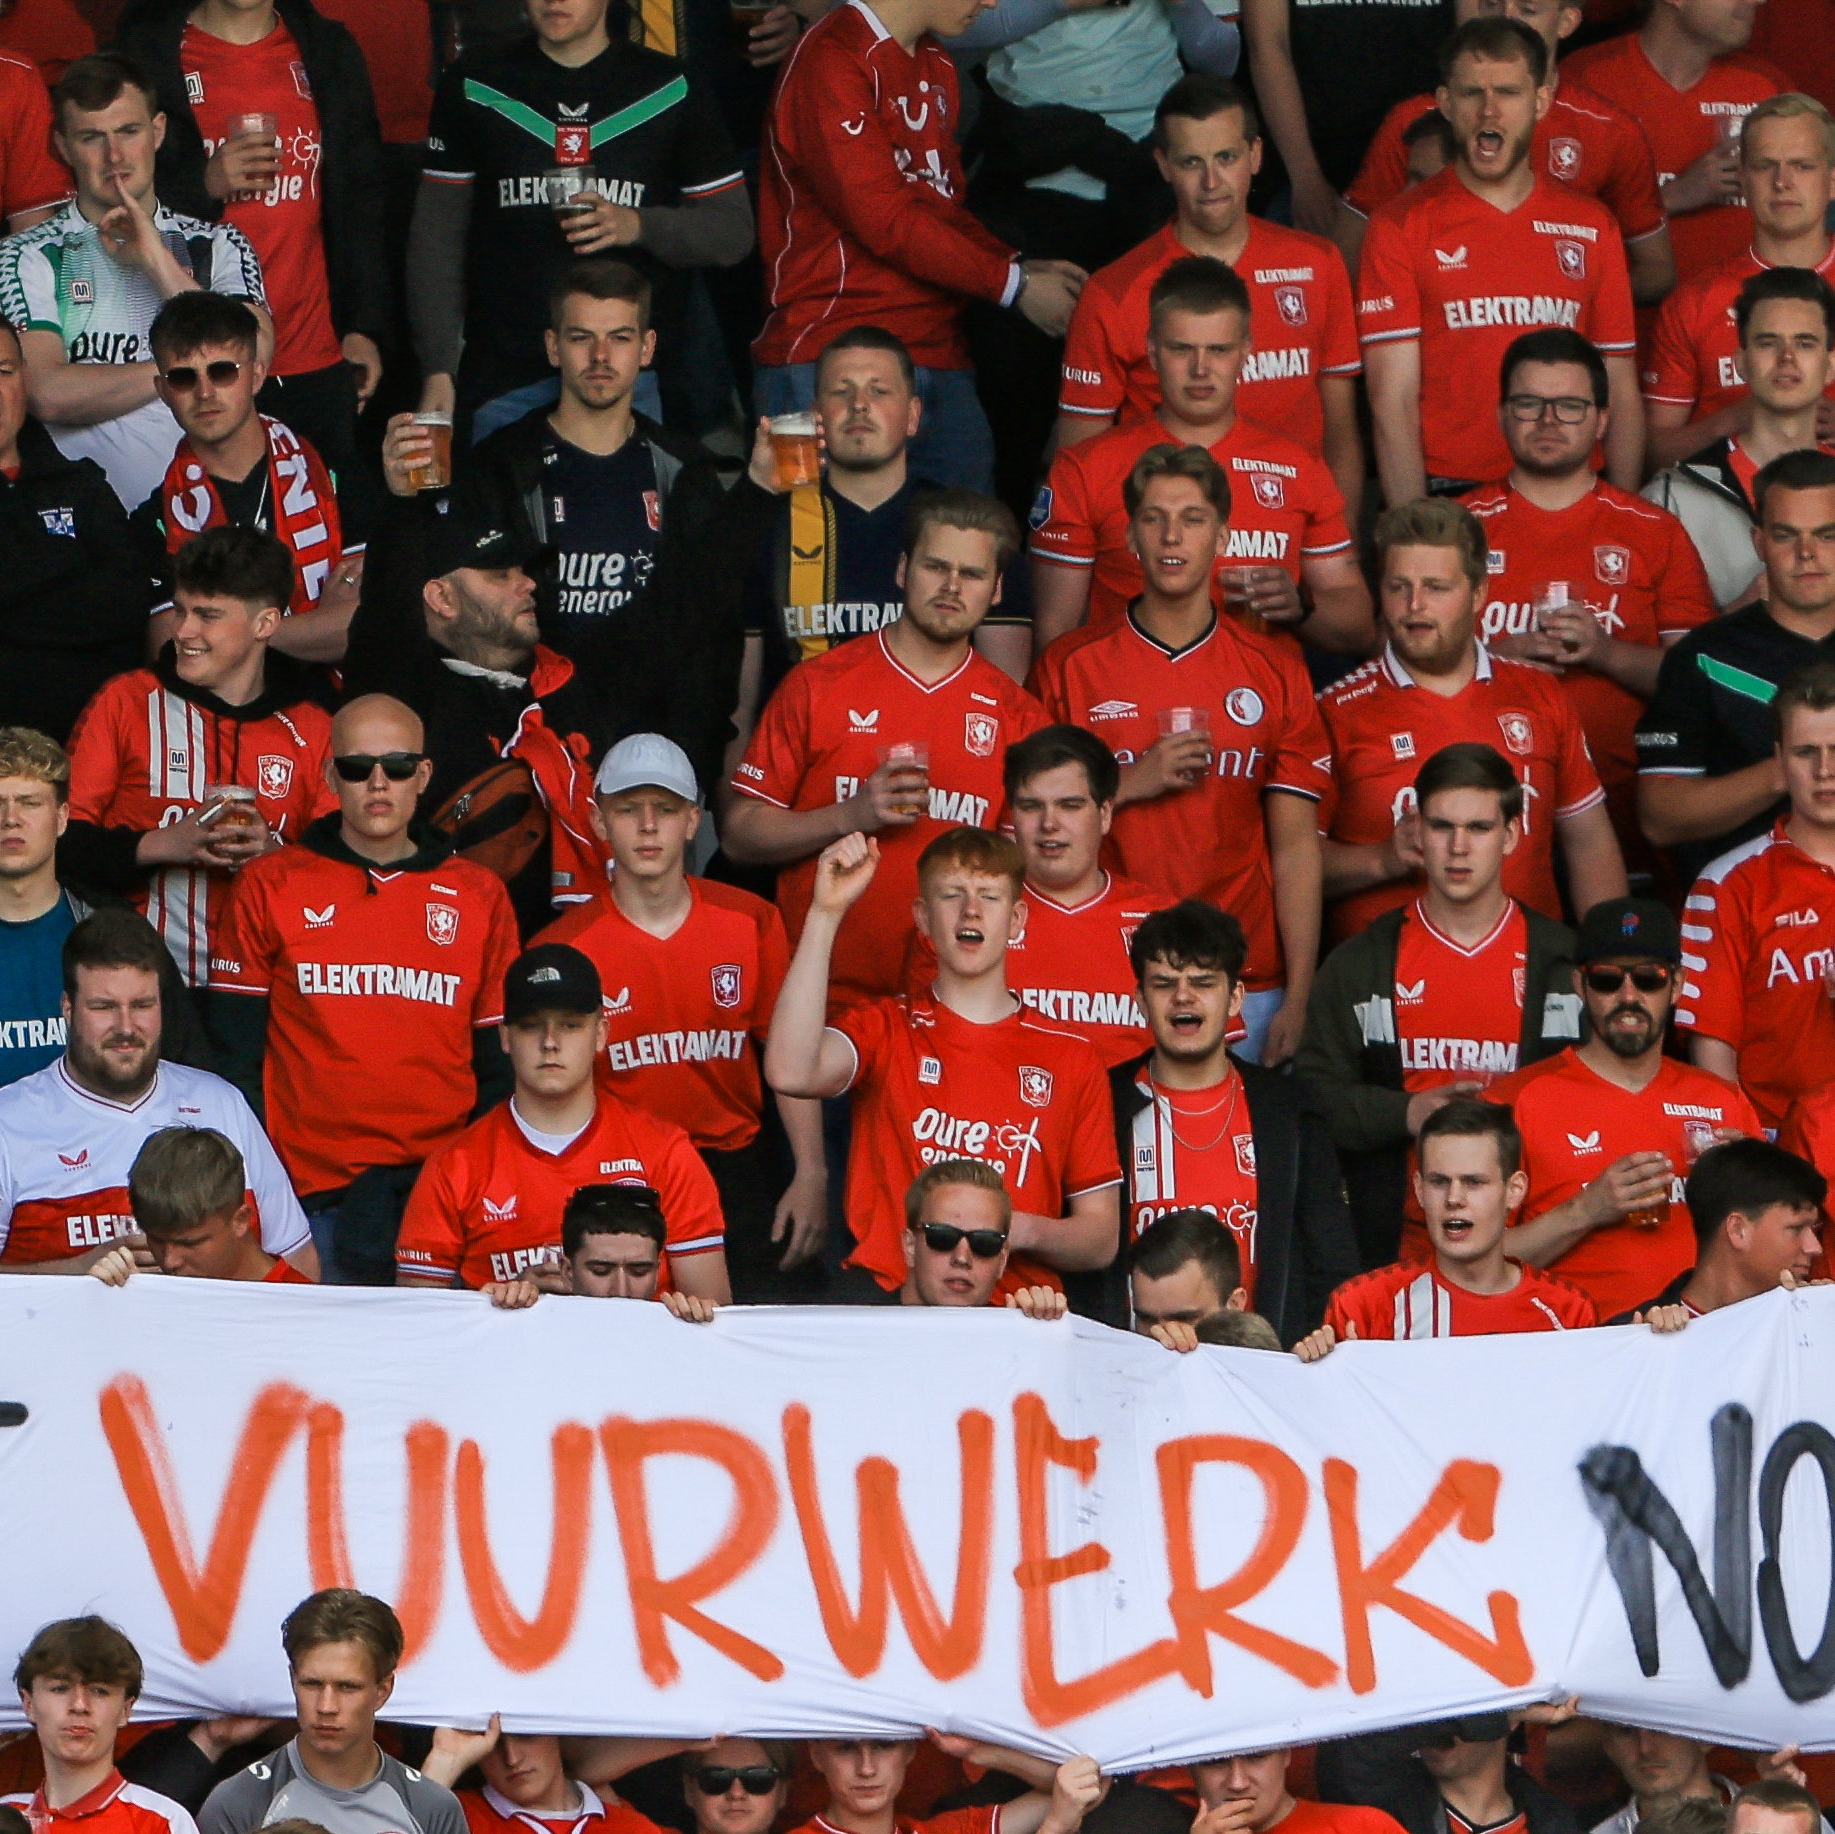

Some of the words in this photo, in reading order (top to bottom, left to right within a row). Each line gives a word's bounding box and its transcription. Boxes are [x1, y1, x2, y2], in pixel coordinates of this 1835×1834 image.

[1532, 219, 1598, 243] ELEKTRAMAT
[1444, 295, 1582, 331] ELEKTRAMAT
[69, 331, 139, 366] pure
[1231, 457, 1297, 479] ELEKTRAMAT
[1775, 907, 1821, 929] FILA
[296, 962, 462, 1008] ELEKTRAMAT
[99, 1370, 1535, 1728] VUURWERK
